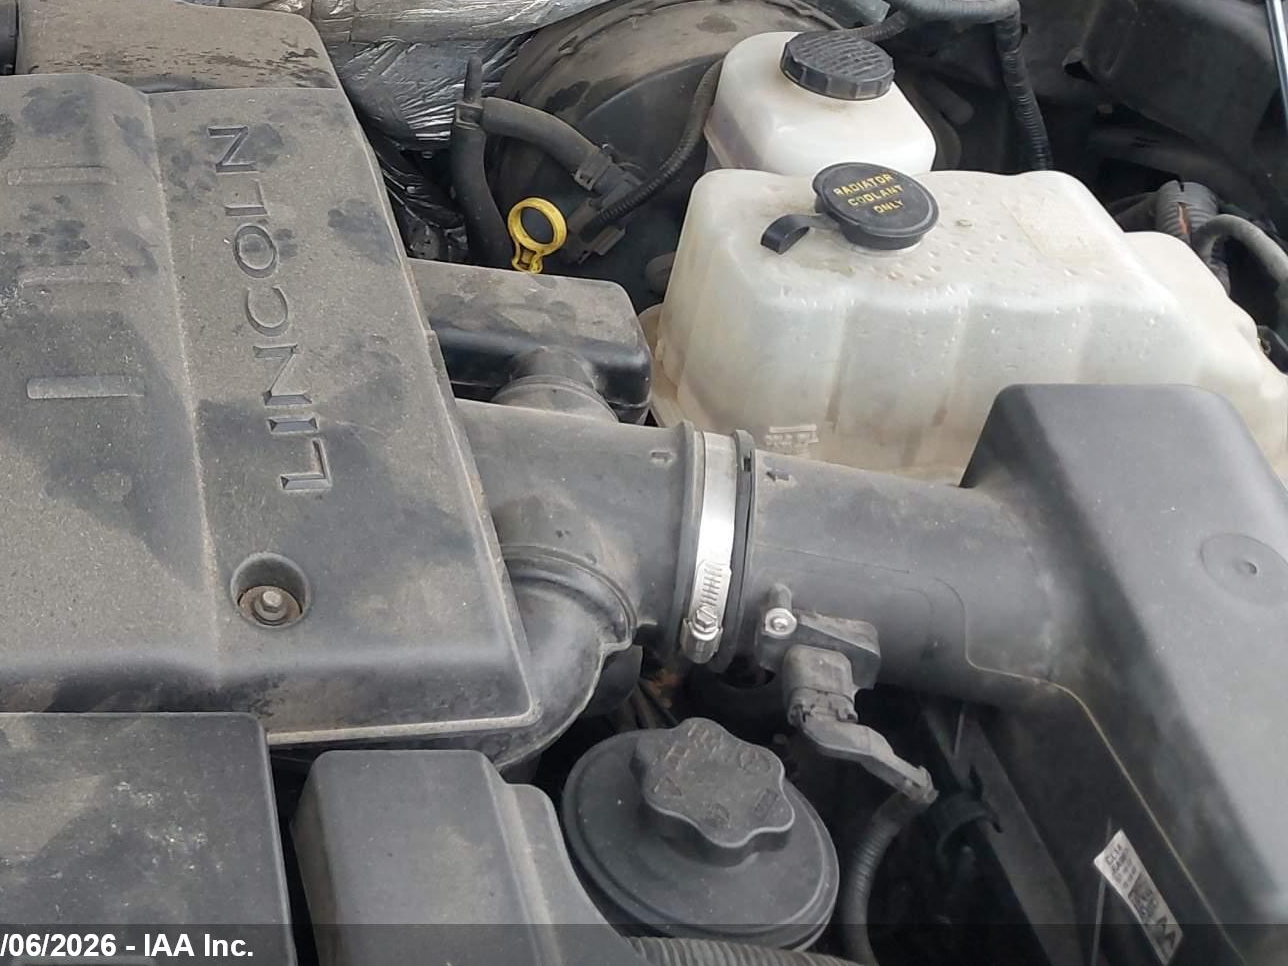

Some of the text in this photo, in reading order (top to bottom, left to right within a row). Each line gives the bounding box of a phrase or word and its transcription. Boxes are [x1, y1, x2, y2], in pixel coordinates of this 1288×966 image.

[832, 173, 894, 195] RADIATOR
[847, 184, 904, 206] COOLANT
[873, 199, 904, 214] ONLY
[208, 126, 332, 490] LINCOLN
